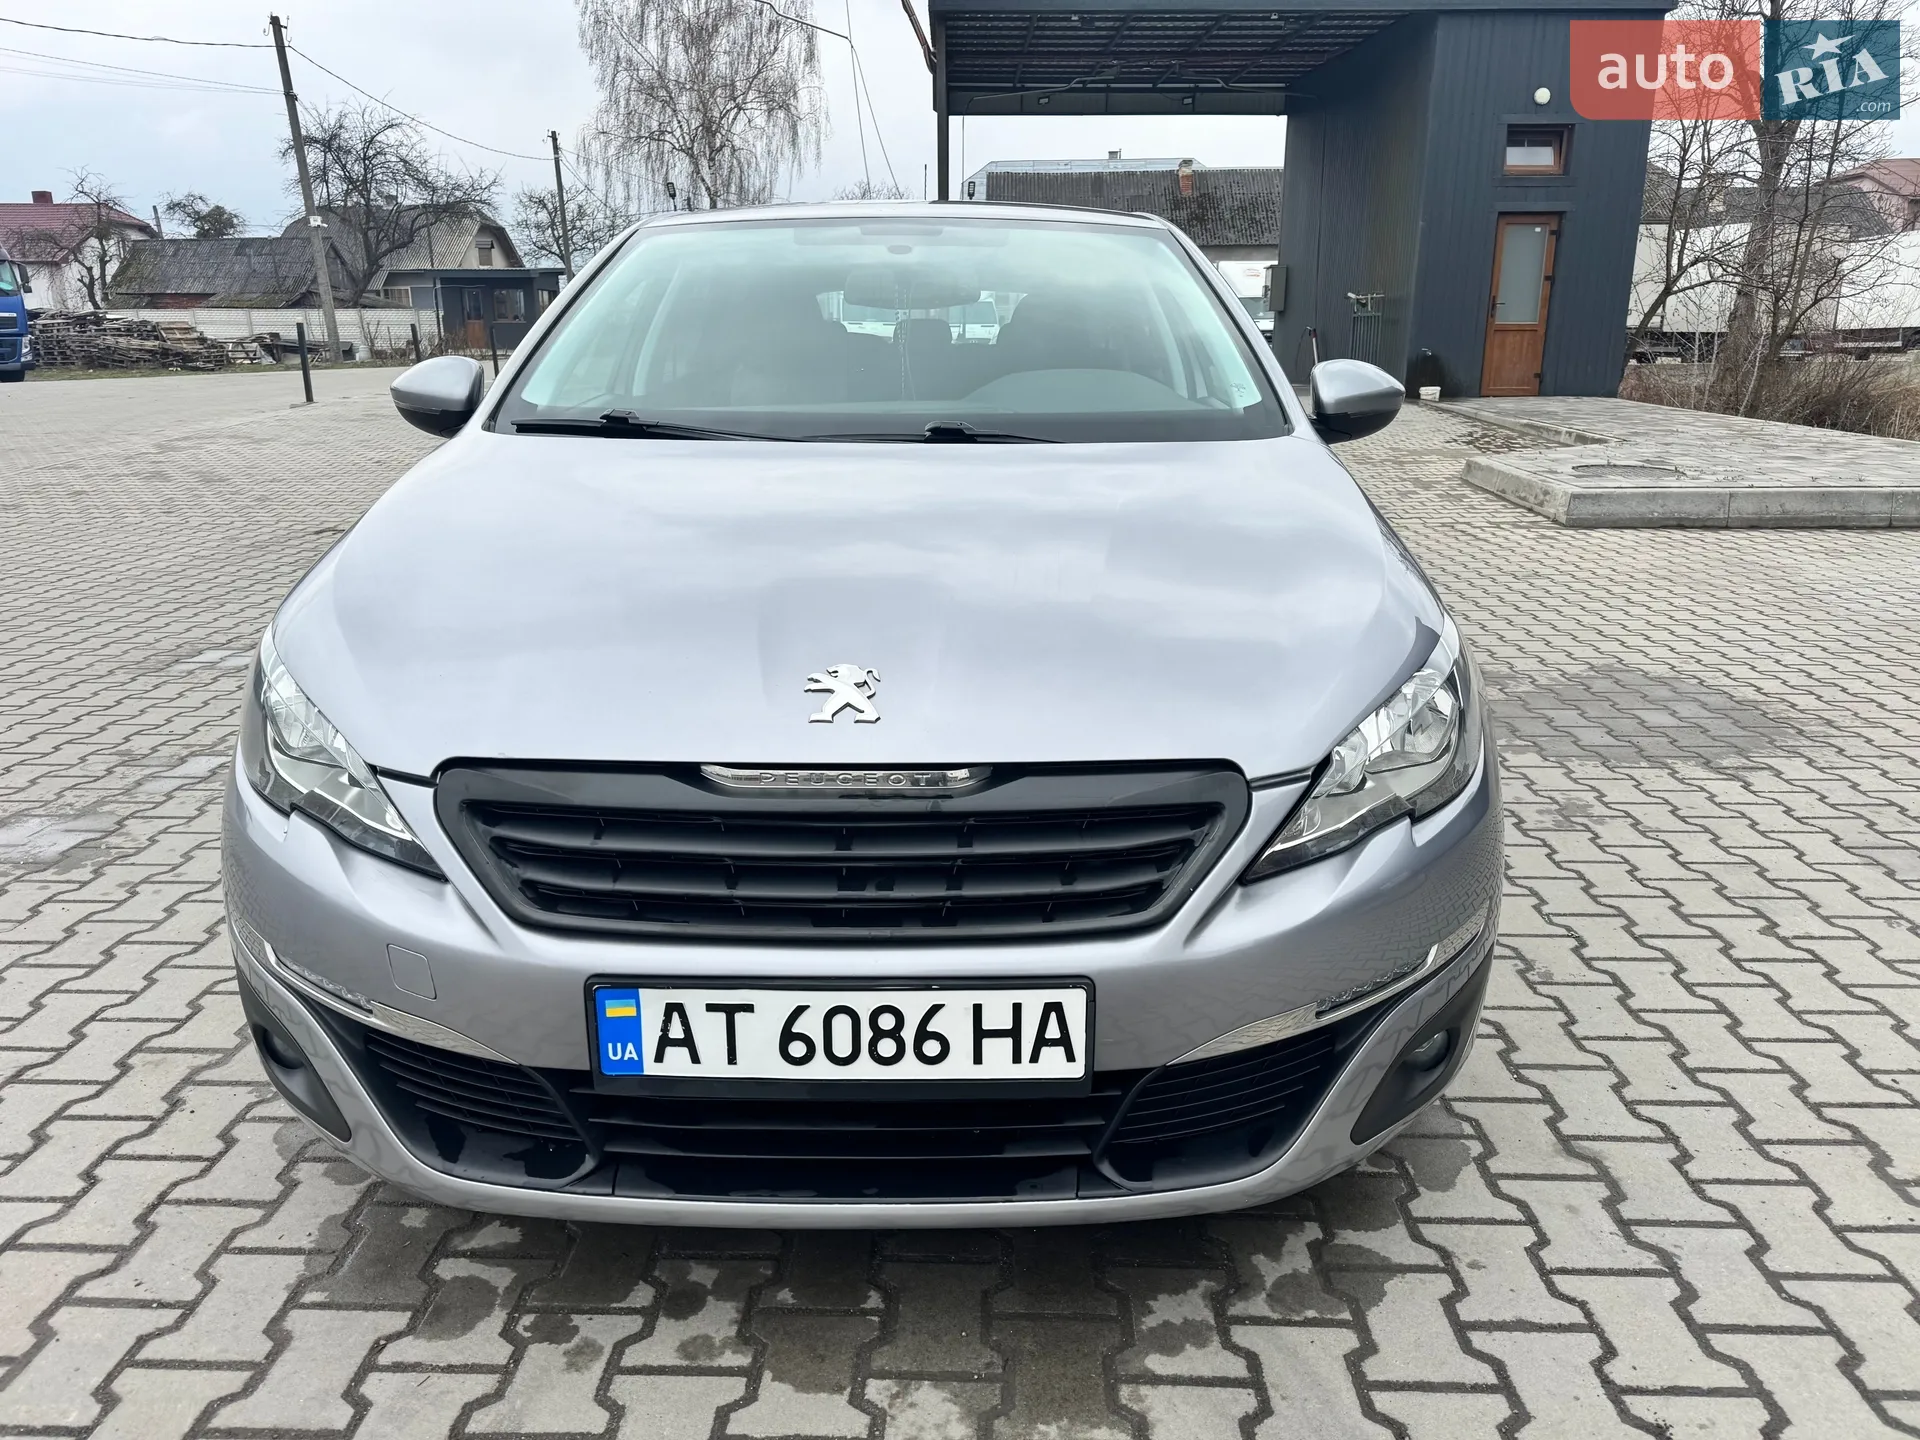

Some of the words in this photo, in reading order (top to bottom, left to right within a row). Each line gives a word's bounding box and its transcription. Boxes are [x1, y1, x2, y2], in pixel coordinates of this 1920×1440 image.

[759, 772, 932, 787] PEUGEOT
[653, 1001, 755, 1066] AT
[778, 1003, 951, 1067] 6086
[972, 1001, 1077, 1064] HA
[607, 1042, 639, 1061] UA
